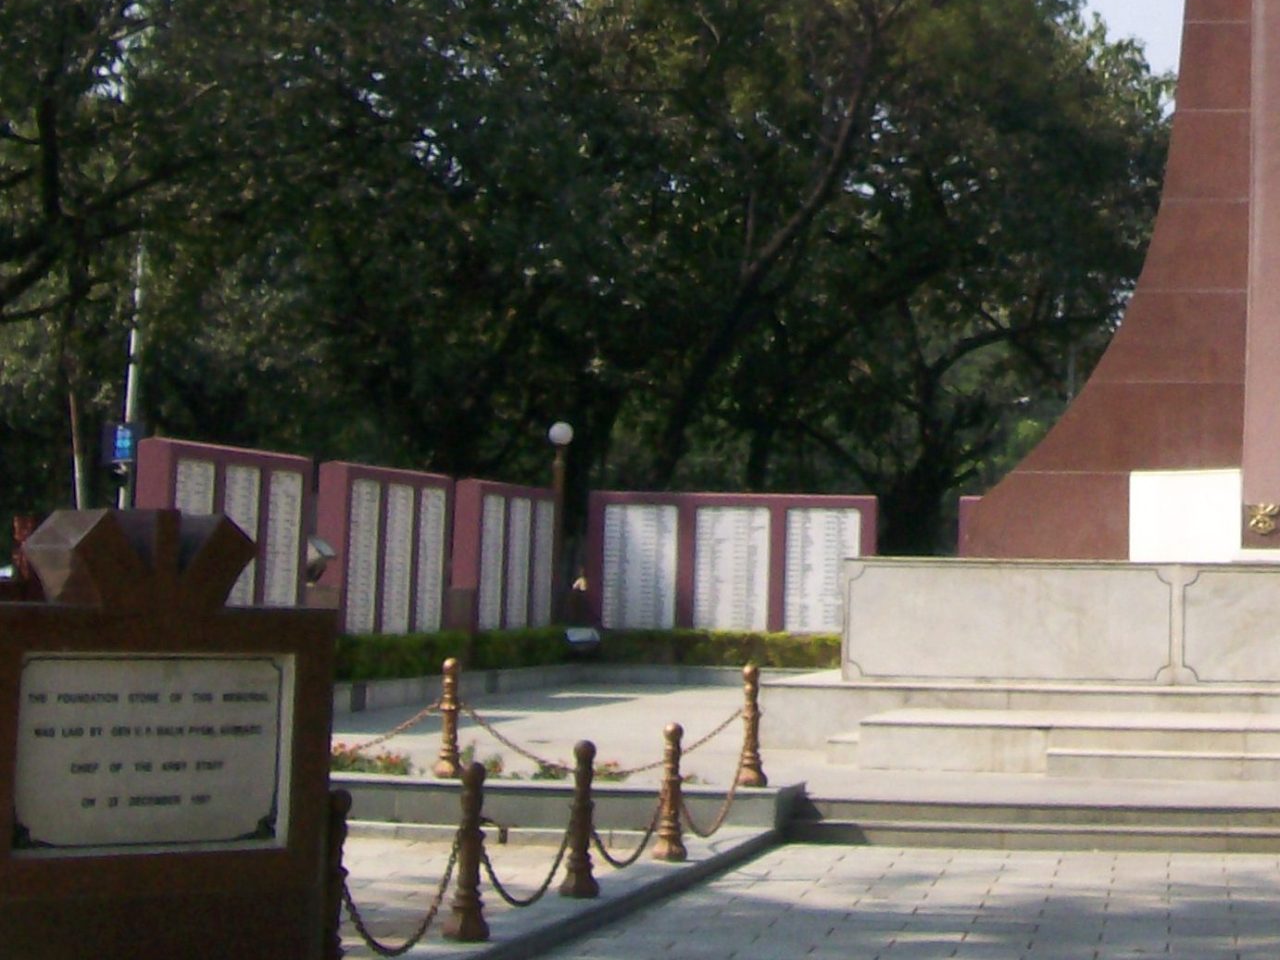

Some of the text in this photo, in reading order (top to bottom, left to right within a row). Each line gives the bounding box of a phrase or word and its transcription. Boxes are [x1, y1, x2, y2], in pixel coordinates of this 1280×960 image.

[28, 694, 47, 704] THE
[57, 694, 118, 704] FOUNDATION
[128, 693, 160, 703] STONE
[34, 726, 54, 738] WAS
[62, 726, 83, 738] LAID
[70, 762, 98, 774] CHIEF
[135, 762, 152, 772] THE
